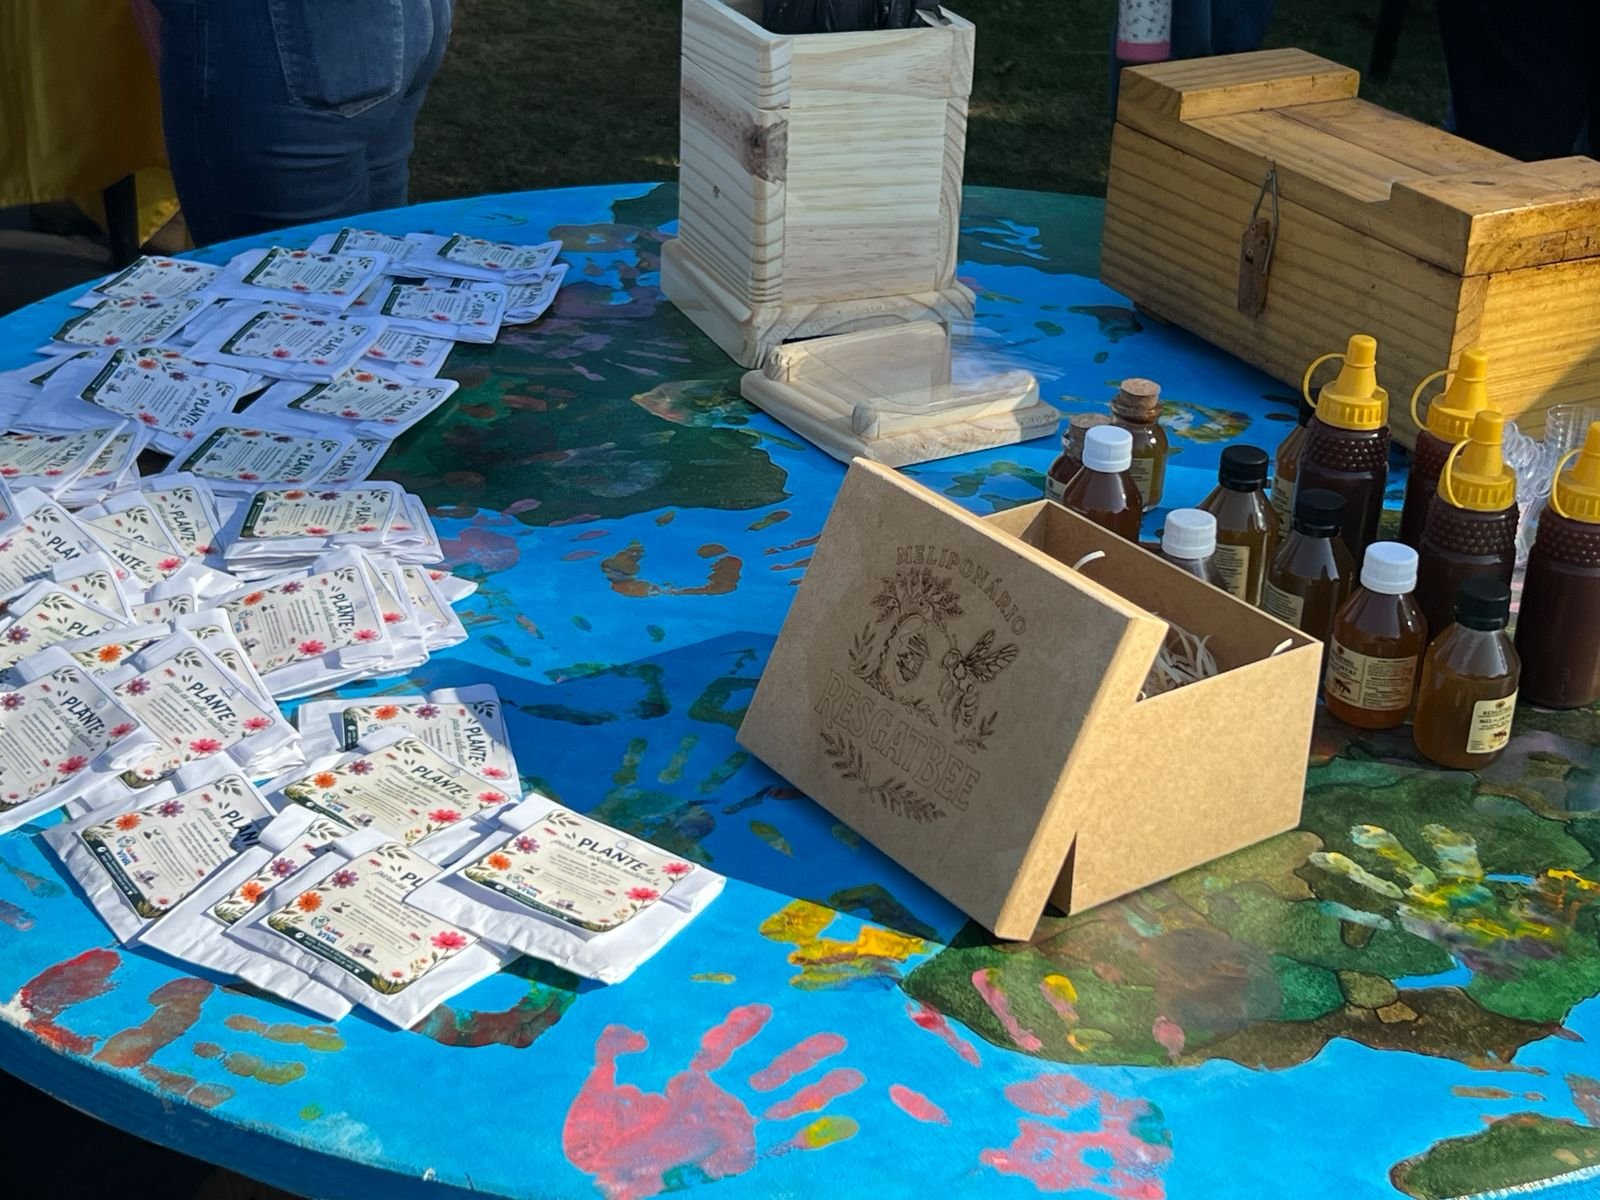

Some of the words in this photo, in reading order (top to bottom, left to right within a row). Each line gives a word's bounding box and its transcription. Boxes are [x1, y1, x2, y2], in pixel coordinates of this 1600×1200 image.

[180, 397, 210, 426] PLANTE
[168, 510, 197, 542] PLANTE
[896, 545, 1026, 635] MELIPONÁRIO
[329, 593, 355, 627] PLANTE
[61, 696, 105, 734] PLANTE
[185, 682, 237, 722] PLANTE
[464, 726, 487, 762] PLANTE
[814, 668, 981, 812] RESGATBEE
[411, 765, 469, 796] PLANTE
[578, 836, 649, 873] PLANTE
